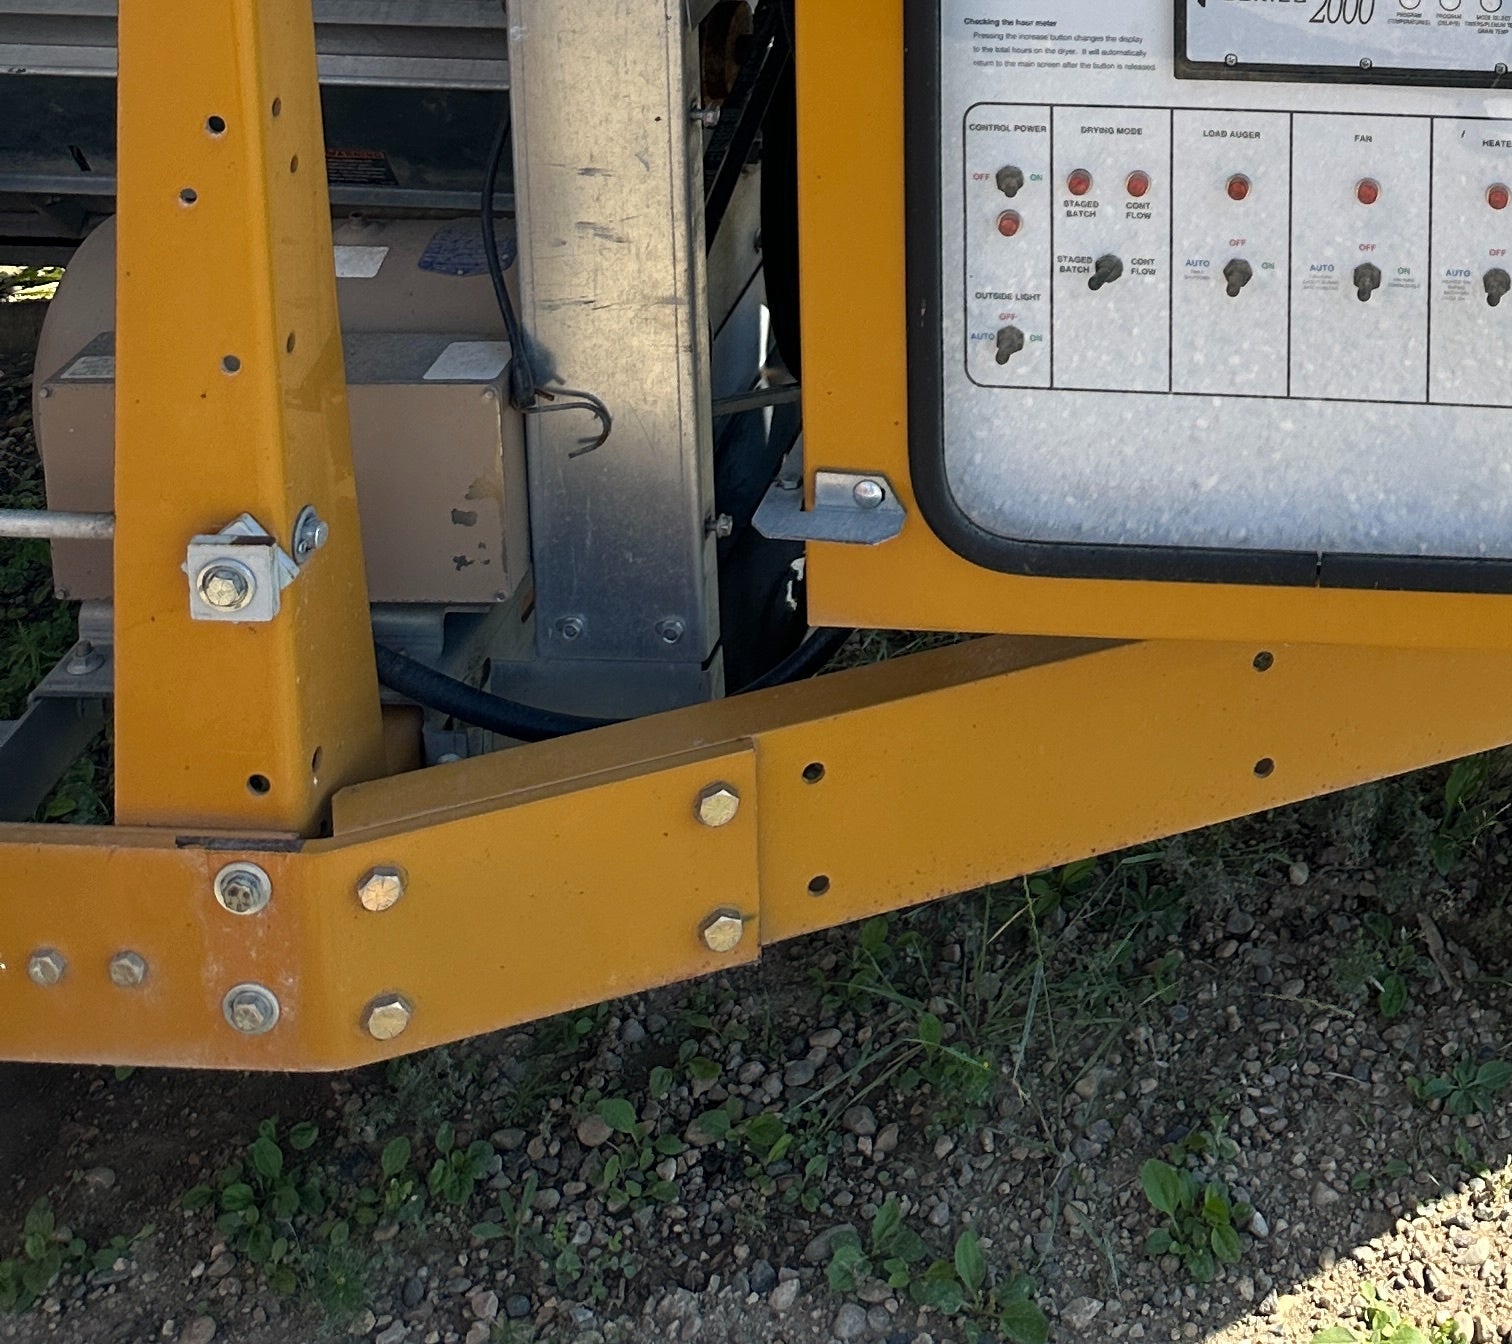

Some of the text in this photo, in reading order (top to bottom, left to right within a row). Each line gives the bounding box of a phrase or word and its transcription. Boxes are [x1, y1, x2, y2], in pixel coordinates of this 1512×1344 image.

[969, 124, 1047, 133] CONTROL POWER
[1081, 126, 1143, 135] DRYING MODE
[1203, 130, 1261, 139] LOAD AUGER
[1063, 200, 1099, 208] STAGED
[1066, 210, 1096, 218] BATCH
[1126, 212, 1152, 220] FLOW
[1229, 239, 1247, 247] OFF
[1359, 244, 1377, 252] OFF
[1057, 256, 1093, 264] STAGED
[1185, 259, 1210, 268] AUTO
[1059, 265, 1090, 274] BATCH
[1261, 262, 1275, 270] ON
[1309, 264, 1335, 272] AUTO
[1397, 267, 1411, 275] ON
[1445, 269, 1471, 277] AUTO
[975, 292, 1012, 300] OUTSIDE
